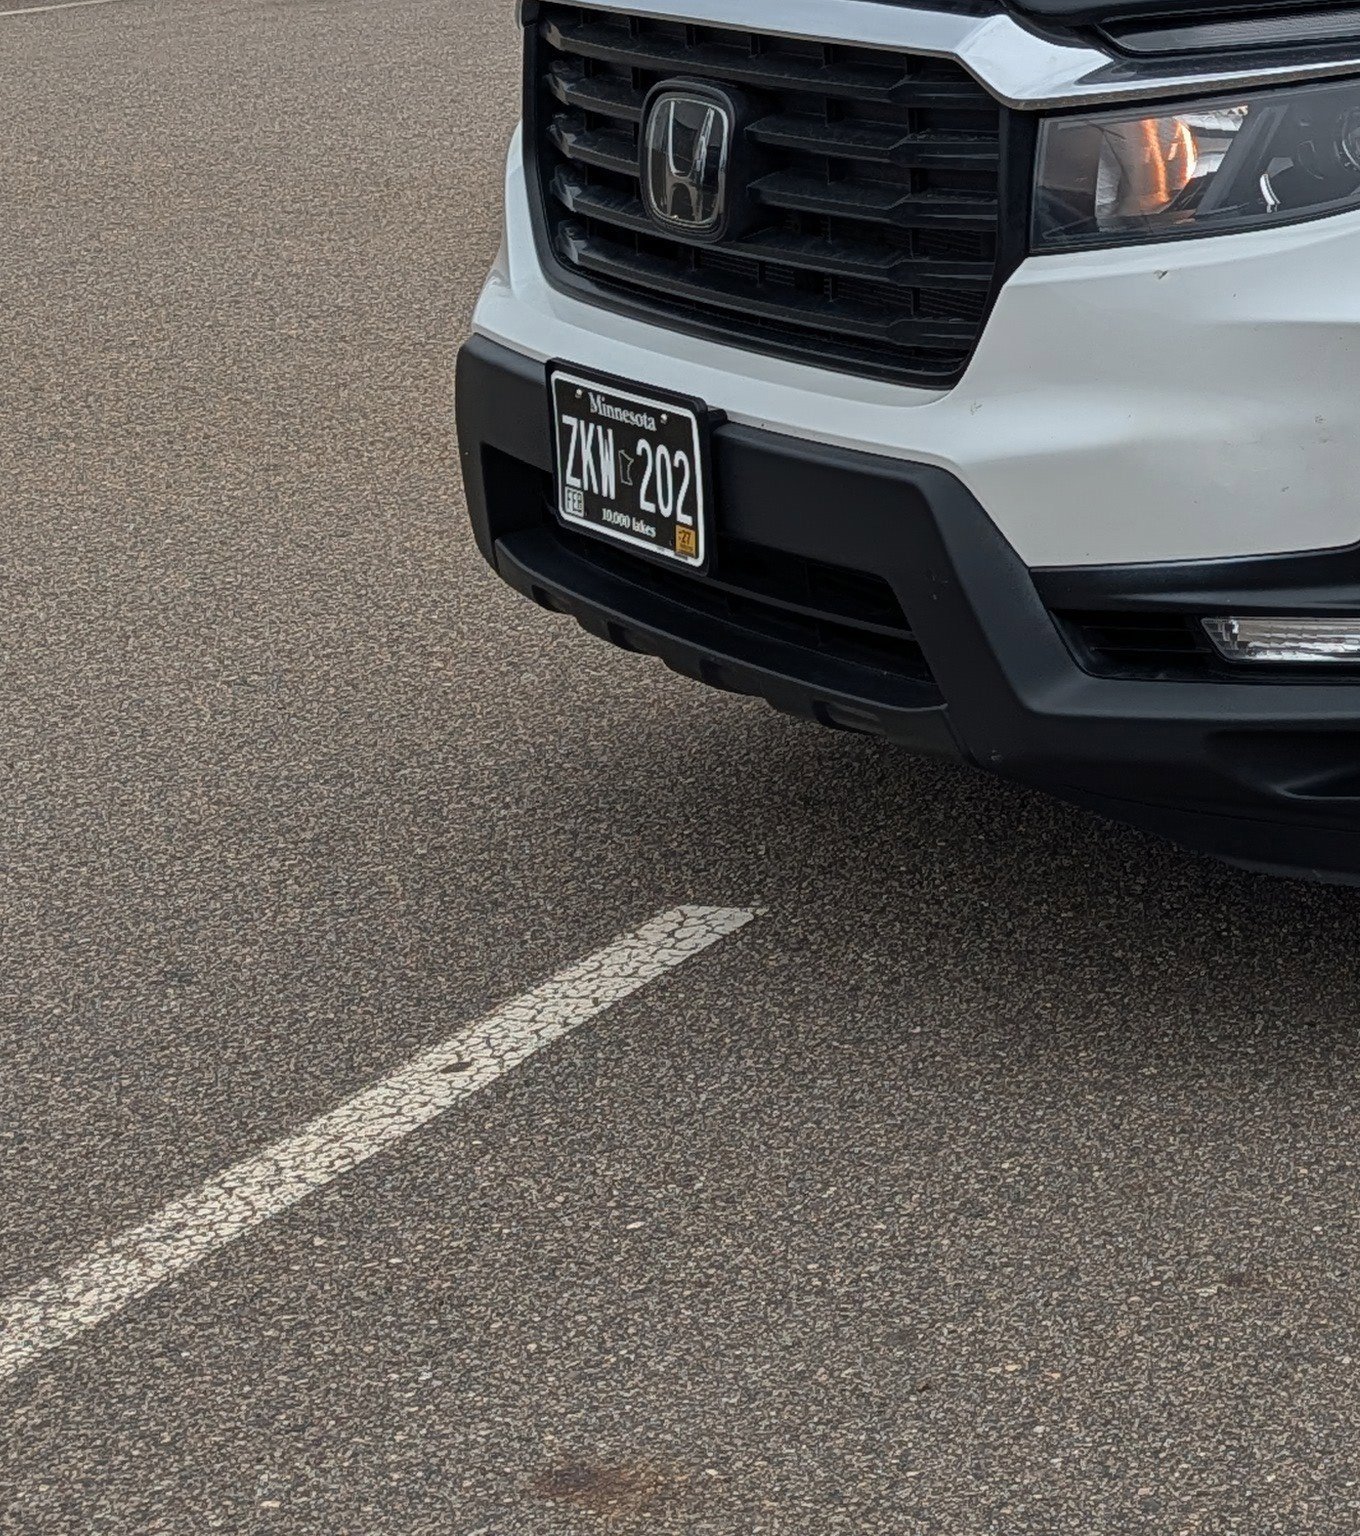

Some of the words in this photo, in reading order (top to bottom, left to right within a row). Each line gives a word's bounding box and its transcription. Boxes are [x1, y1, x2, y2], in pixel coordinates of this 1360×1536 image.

[588, 391, 658, 432] Minnesota
[561, 414, 616, 500] ZKW
[635, 438, 694, 526] 202
[601, 508, 631, 530] 10,000
[631, 516, 657, 538] lakes
